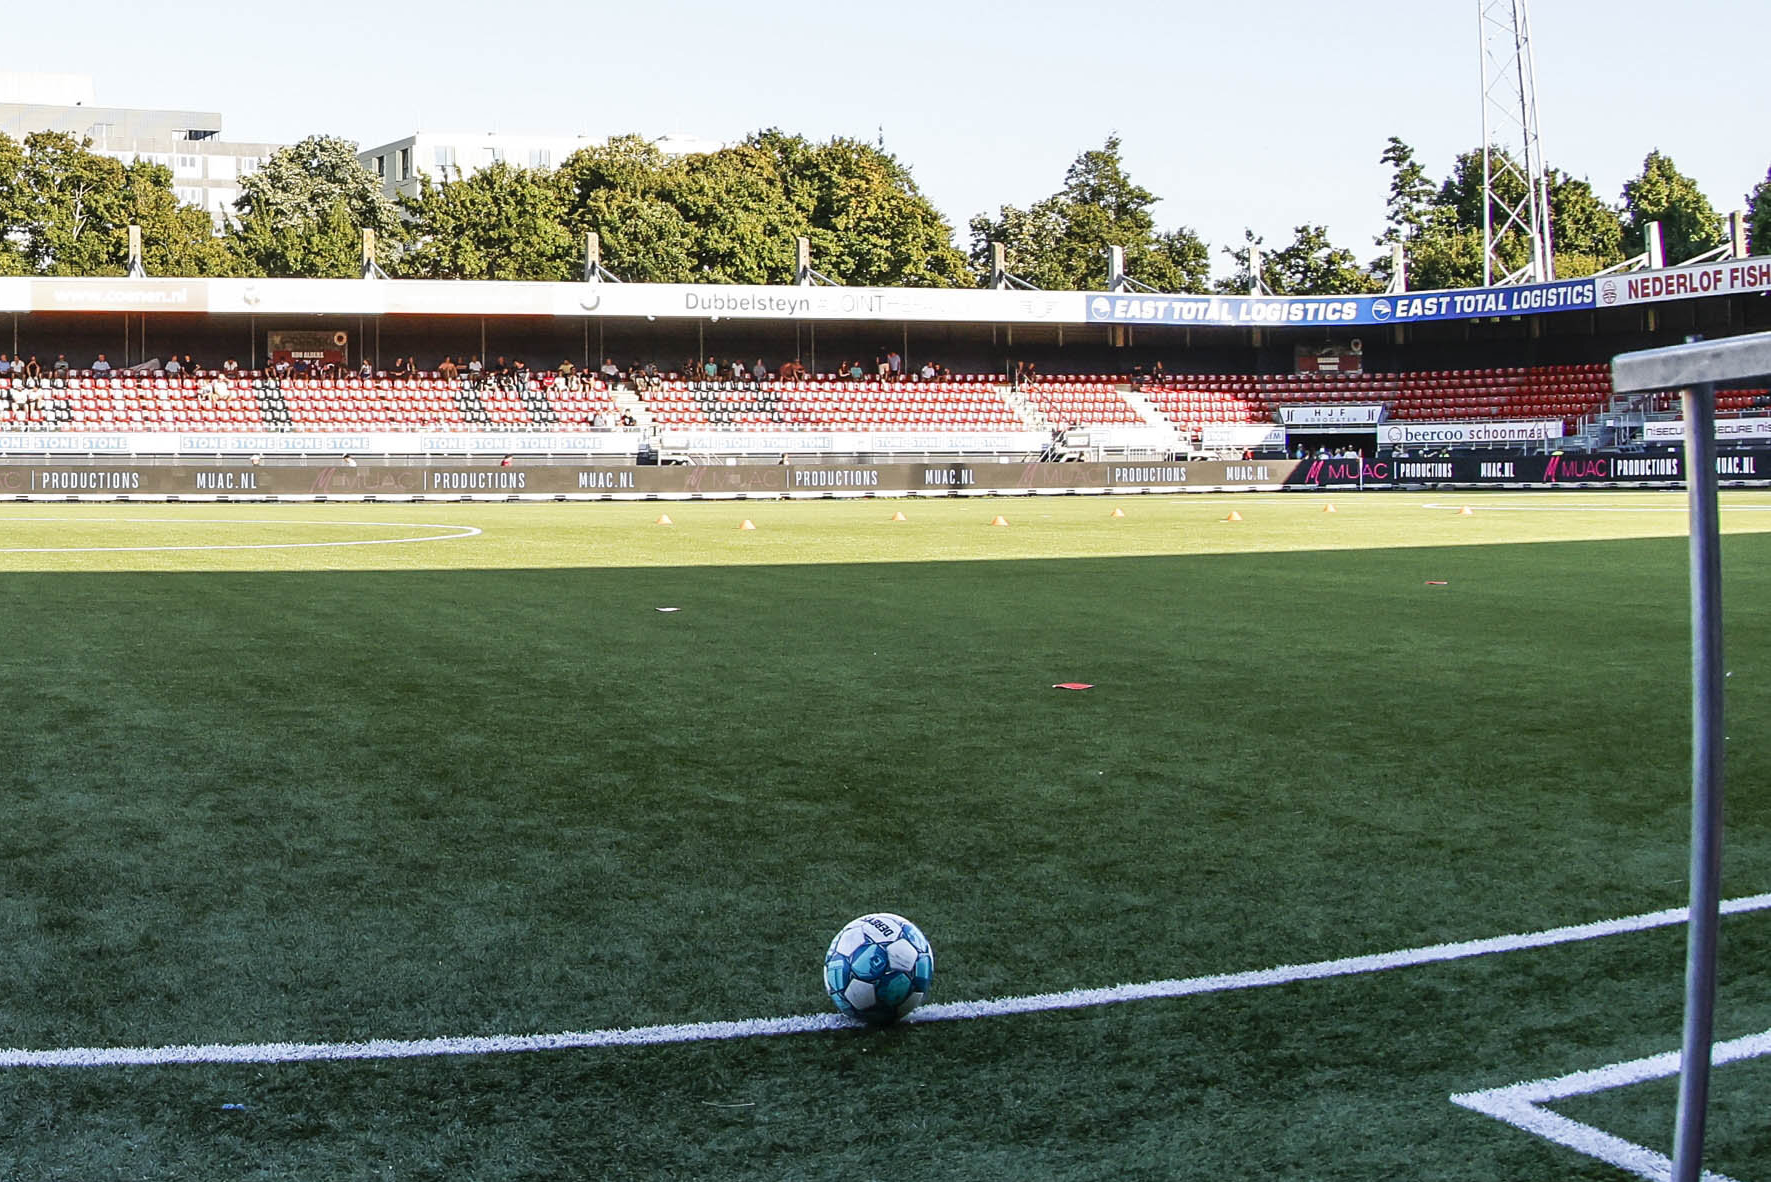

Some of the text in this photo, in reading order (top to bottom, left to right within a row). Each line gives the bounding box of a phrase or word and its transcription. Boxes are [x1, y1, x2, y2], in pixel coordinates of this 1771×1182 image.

[1628, 269, 1723, 300] NEDERLOF
[685, 292, 810, 315] Dubbelsteyn
[1395, 284, 1594, 318] EAST TOTAL LOGISTICS
[1114, 299, 1357, 321] EAST TOTAL LOGISTICS
[34, 437, 78, 449] STONE
[83, 437, 128, 449] STONE
[183, 437, 371, 449] STONE STONE STONE STONE
[425, 437, 602, 449] STONE STONE STONE STONE
[1405, 427, 1463, 442] beercoo
[1115, 466, 1186, 483] PRODUCTIONS
[1226, 466, 1270, 481] MUAC.NL
[1400, 462, 1453, 478] PRODUCTIONS
[1480, 462, 1515, 478] MUAC.NL
[1617, 458, 1678, 476] PRODUCTIONS
[42, 472, 140, 489] PRODUCTIONS
[196, 472, 257, 489] MUAC.NL
[434, 472, 526, 489] PRODUCTIONS
[578, 472, 635, 489] MUAC.NL
[795, 470, 878, 487] PRODUCTIONS
[925, 469, 975, 486] MUAC.NL
